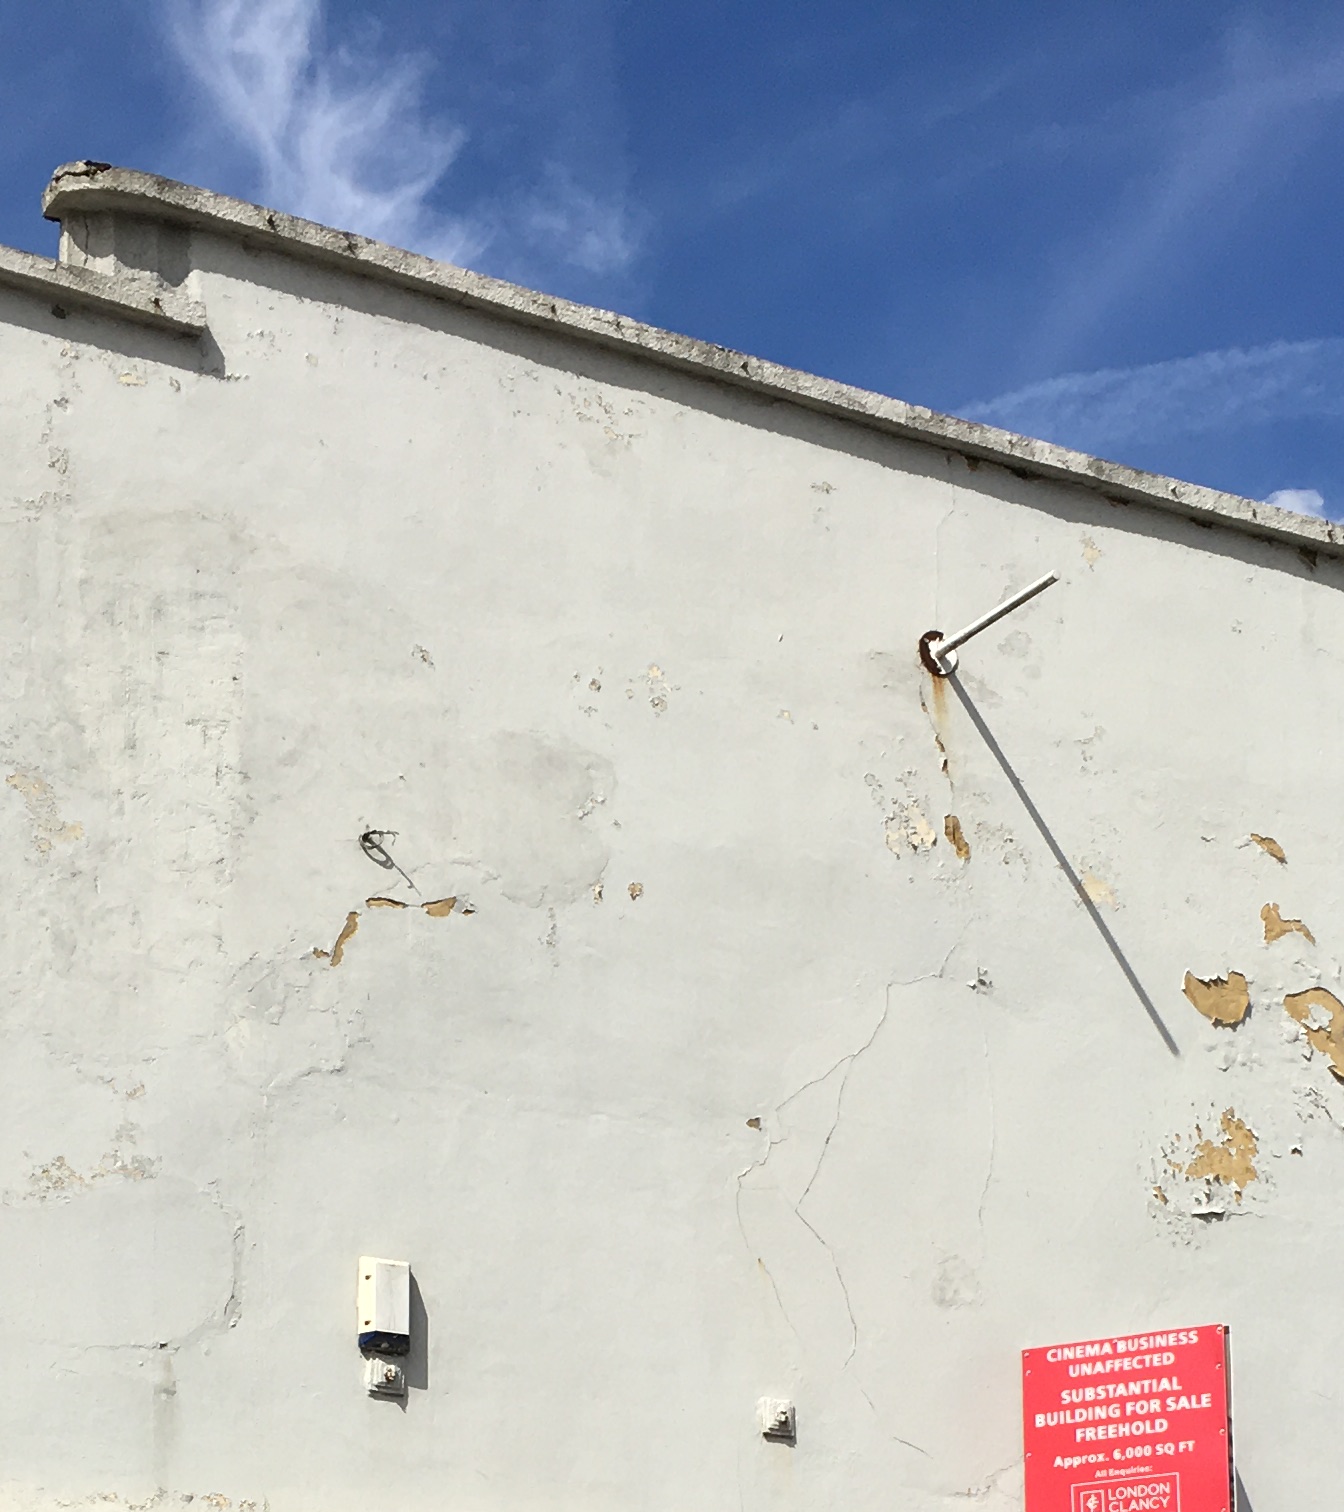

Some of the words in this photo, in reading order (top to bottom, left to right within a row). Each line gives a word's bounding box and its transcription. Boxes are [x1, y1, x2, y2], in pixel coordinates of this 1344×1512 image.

[1047, 1343, 1113, 1362] CINEMA
[1117, 1330, 1199, 1354] BUSINESS
[1068, 1352, 1175, 1377] UNAFFECTED
[1061, 1377, 1182, 1404] SUBSTANTIAL
[1035, 1404, 1120, 1428] BUILDING
[1126, 1399, 1161, 1417] FOR
[1166, 1393, 1212, 1412] SALE
[1075, 1419, 1168, 1442] FREEHOLD
[1053, 1452, 1109, 1469] Approx.
[1113, 1444, 1152, 1461] 6,000
[1155, 1442, 1175, 1456] SQ
[1179, 1440, 1195, 1452] FT
[1108, 1482, 1171, 1501] LONDON
